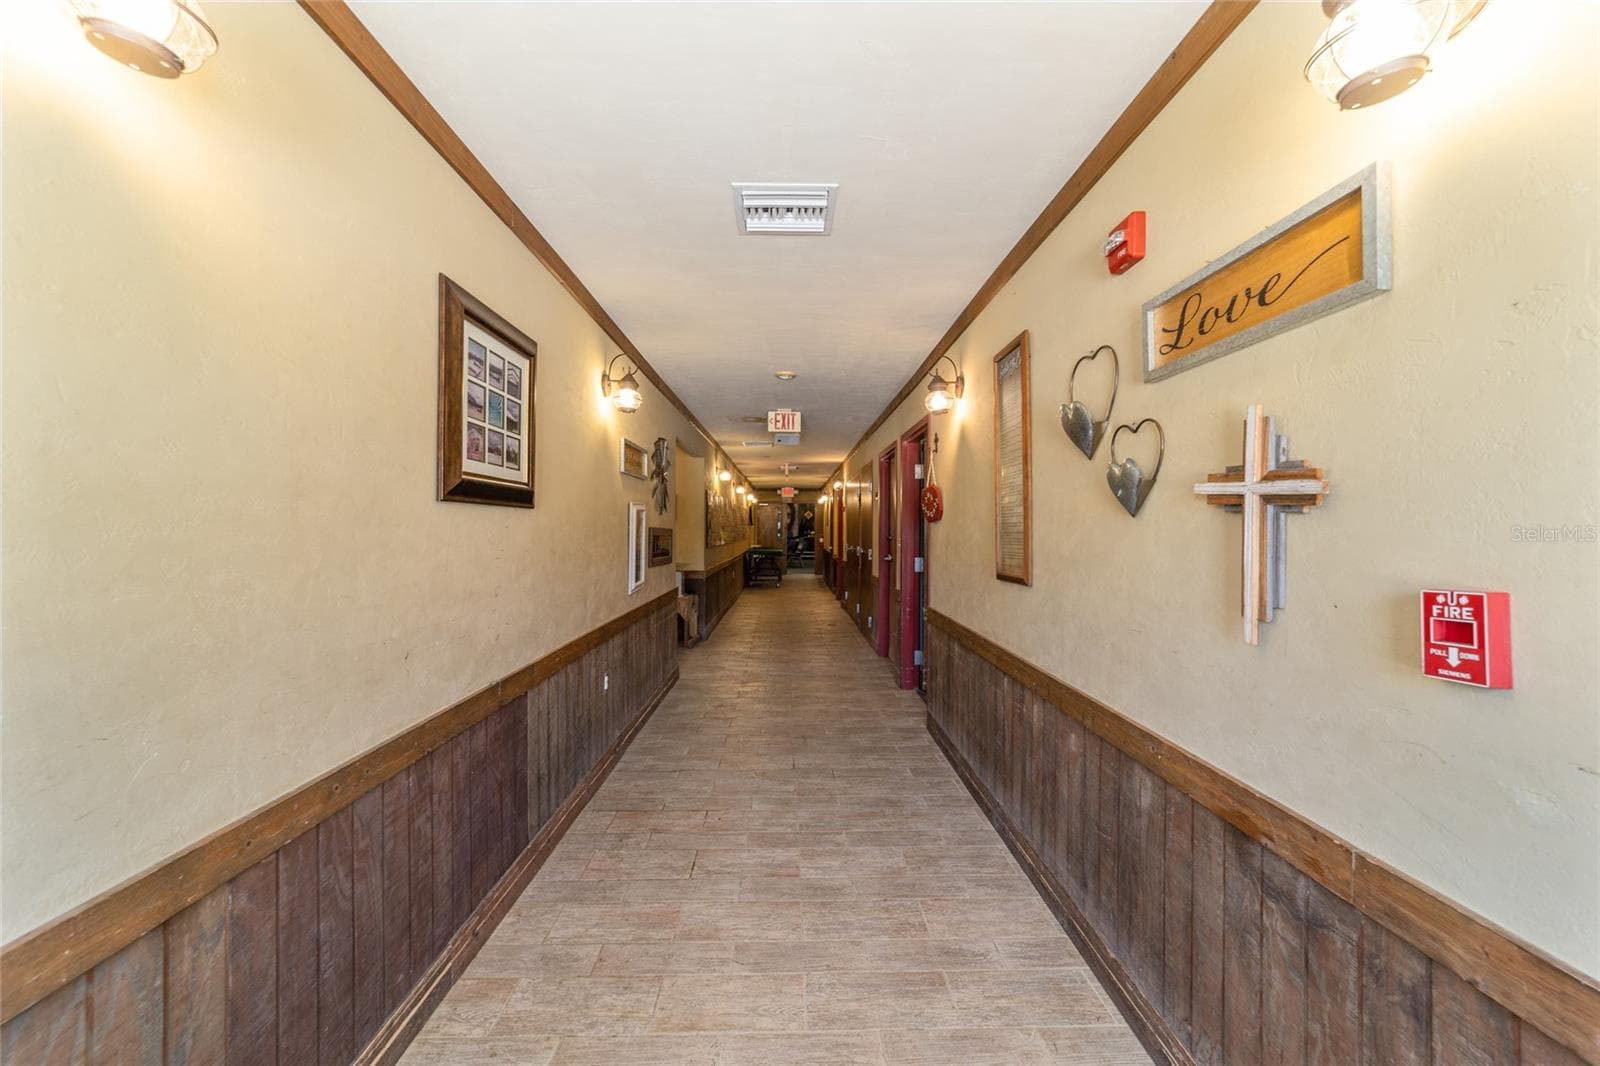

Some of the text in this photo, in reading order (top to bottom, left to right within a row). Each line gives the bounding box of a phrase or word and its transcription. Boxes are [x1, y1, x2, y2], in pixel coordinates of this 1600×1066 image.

[1159, 235, 1350, 356] Love
[774, 412, 796, 430] EXIT
[1432, 605, 1474, 620] FIRE
